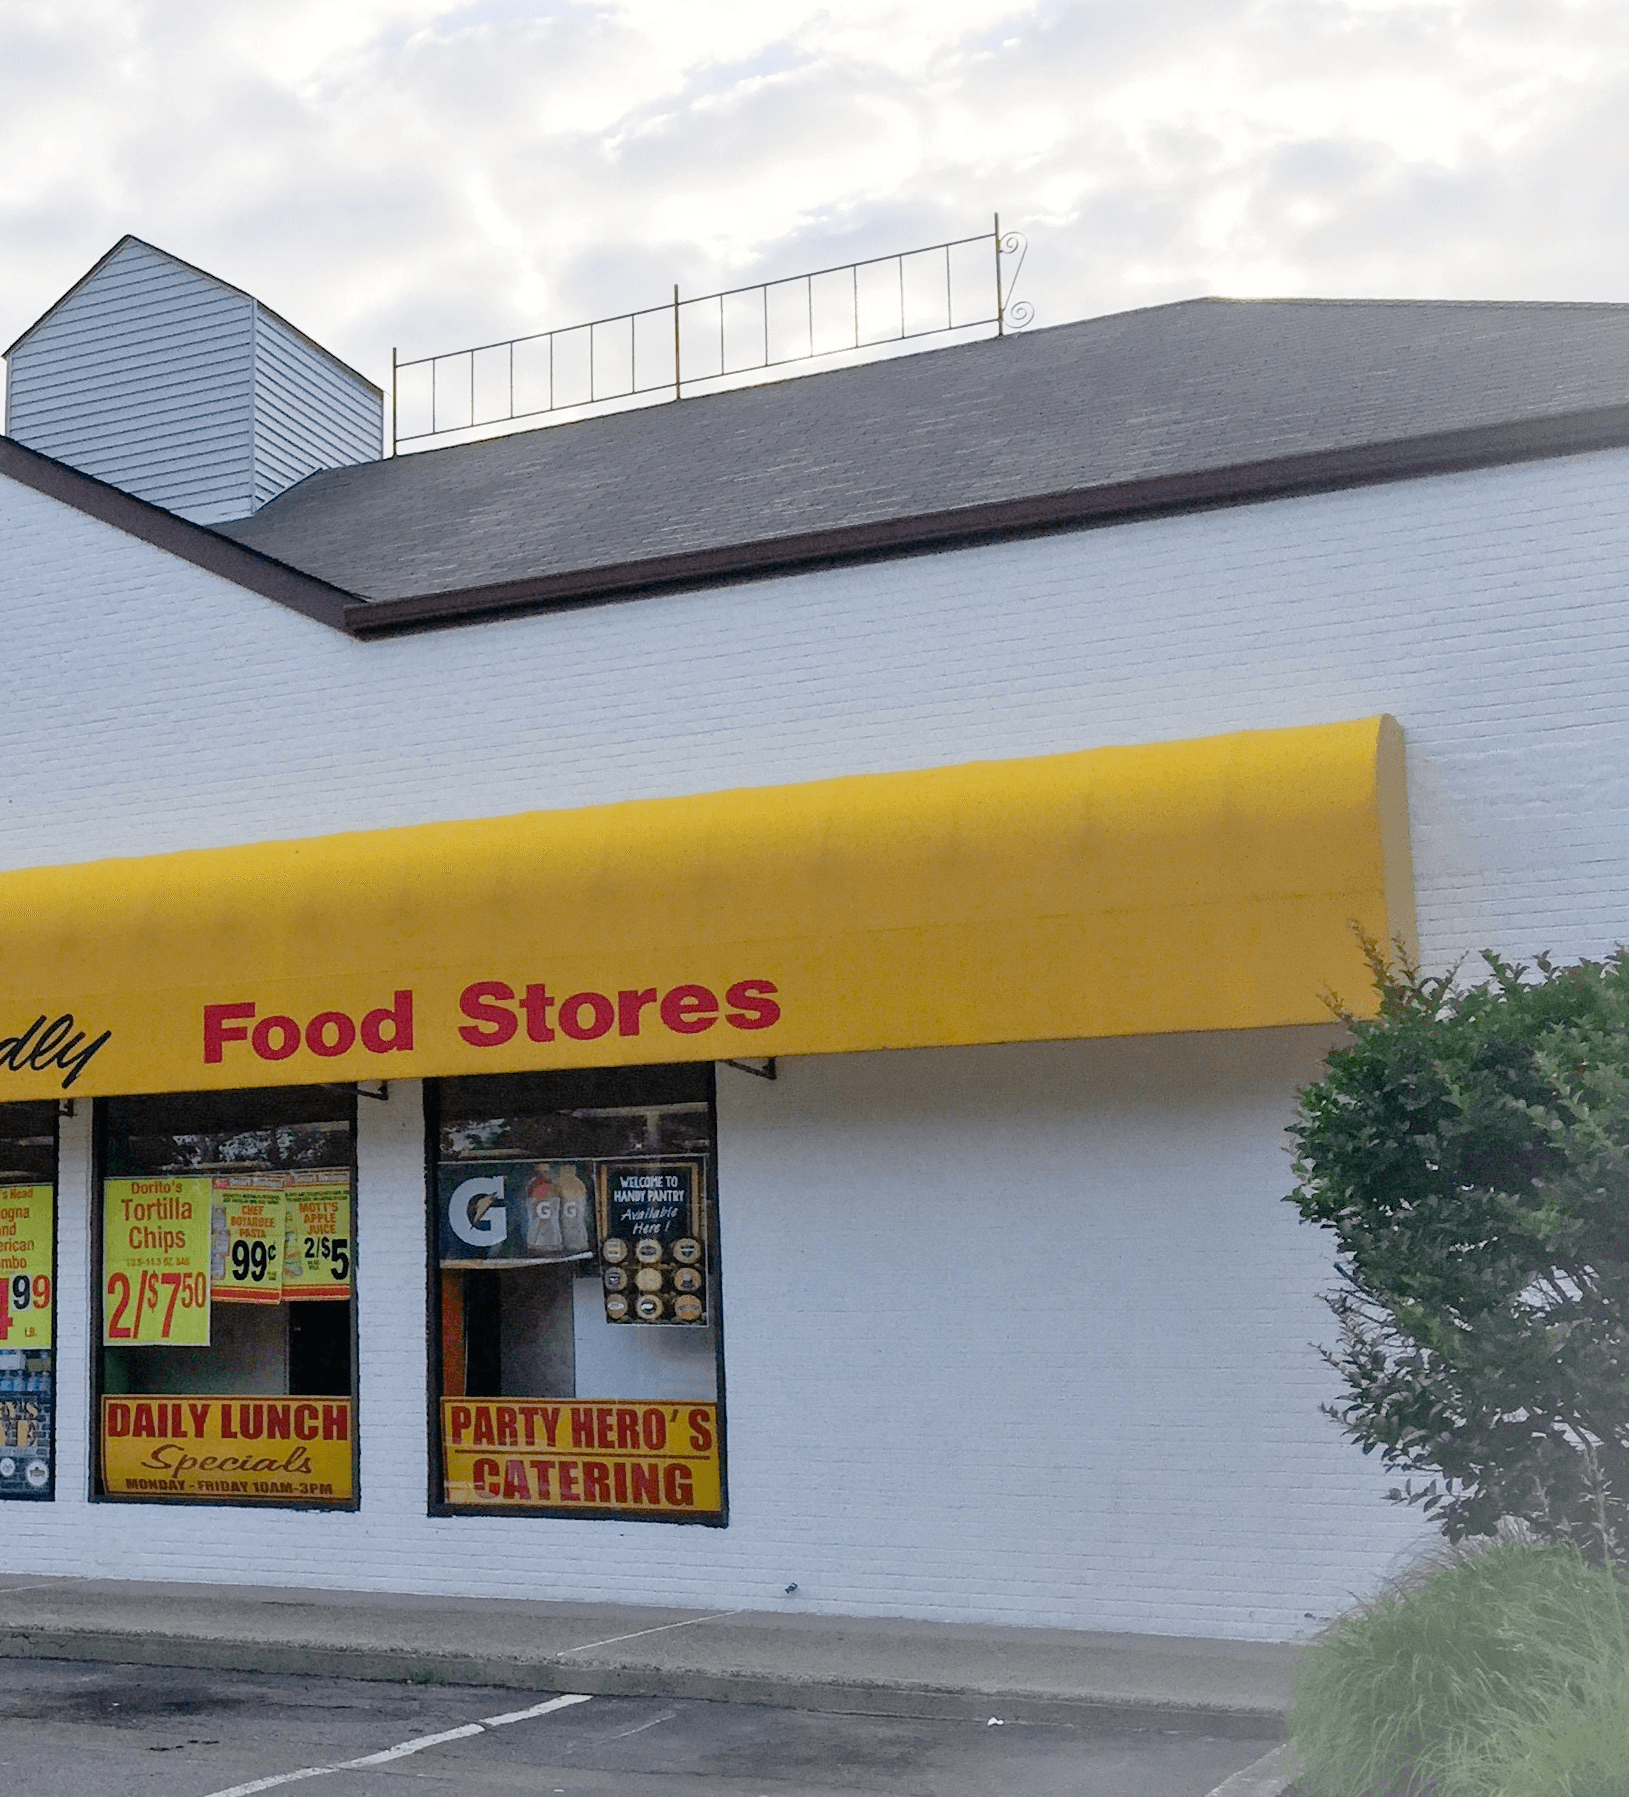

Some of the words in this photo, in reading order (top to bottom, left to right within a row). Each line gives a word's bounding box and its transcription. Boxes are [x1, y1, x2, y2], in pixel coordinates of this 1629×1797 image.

[203, 990, 414, 1064] Food
[457, 979, 783, 1047] Stores
[131, 1181, 183, 1195] Dorito's
[619, 1176, 663, 1188] WELCOME
[666, 1176, 678, 1188] TO
[614, 1190, 645, 1202] HANDY
[647, 1189, 684, 1202] PANTRY
[121, 1197, 193, 1222] Tortilla
[241, 1205, 264, 1215] CHEF
[298, 1201, 338, 1213] MOTT'S
[448, 1175, 508, 1247] G
[620, 1206, 678, 1221] Available
[303, 1213, 337, 1224] APPLE
[239, 1228, 267, 1239] PASTA
[306, 1224, 337, 1235] JUICE
[128, 1225, 186, 1253] Chips
[108, 1403, 211, 1438] DAILY
[221, 1403, 348, 1440] LUNCH
[451, 1405, 560, 1447] PARTY
[570, 1407, 713, 1451] HERO'S
[141, 1443, 312, 1478] Specials
[125, 1478, 185, 1492] MONDAY
[197, 1480, 249, 1493] FRIDAY
[252, 1482, 333, 1495] 10AM-3PM
[473, 1458, 694, 1506] CATERING
